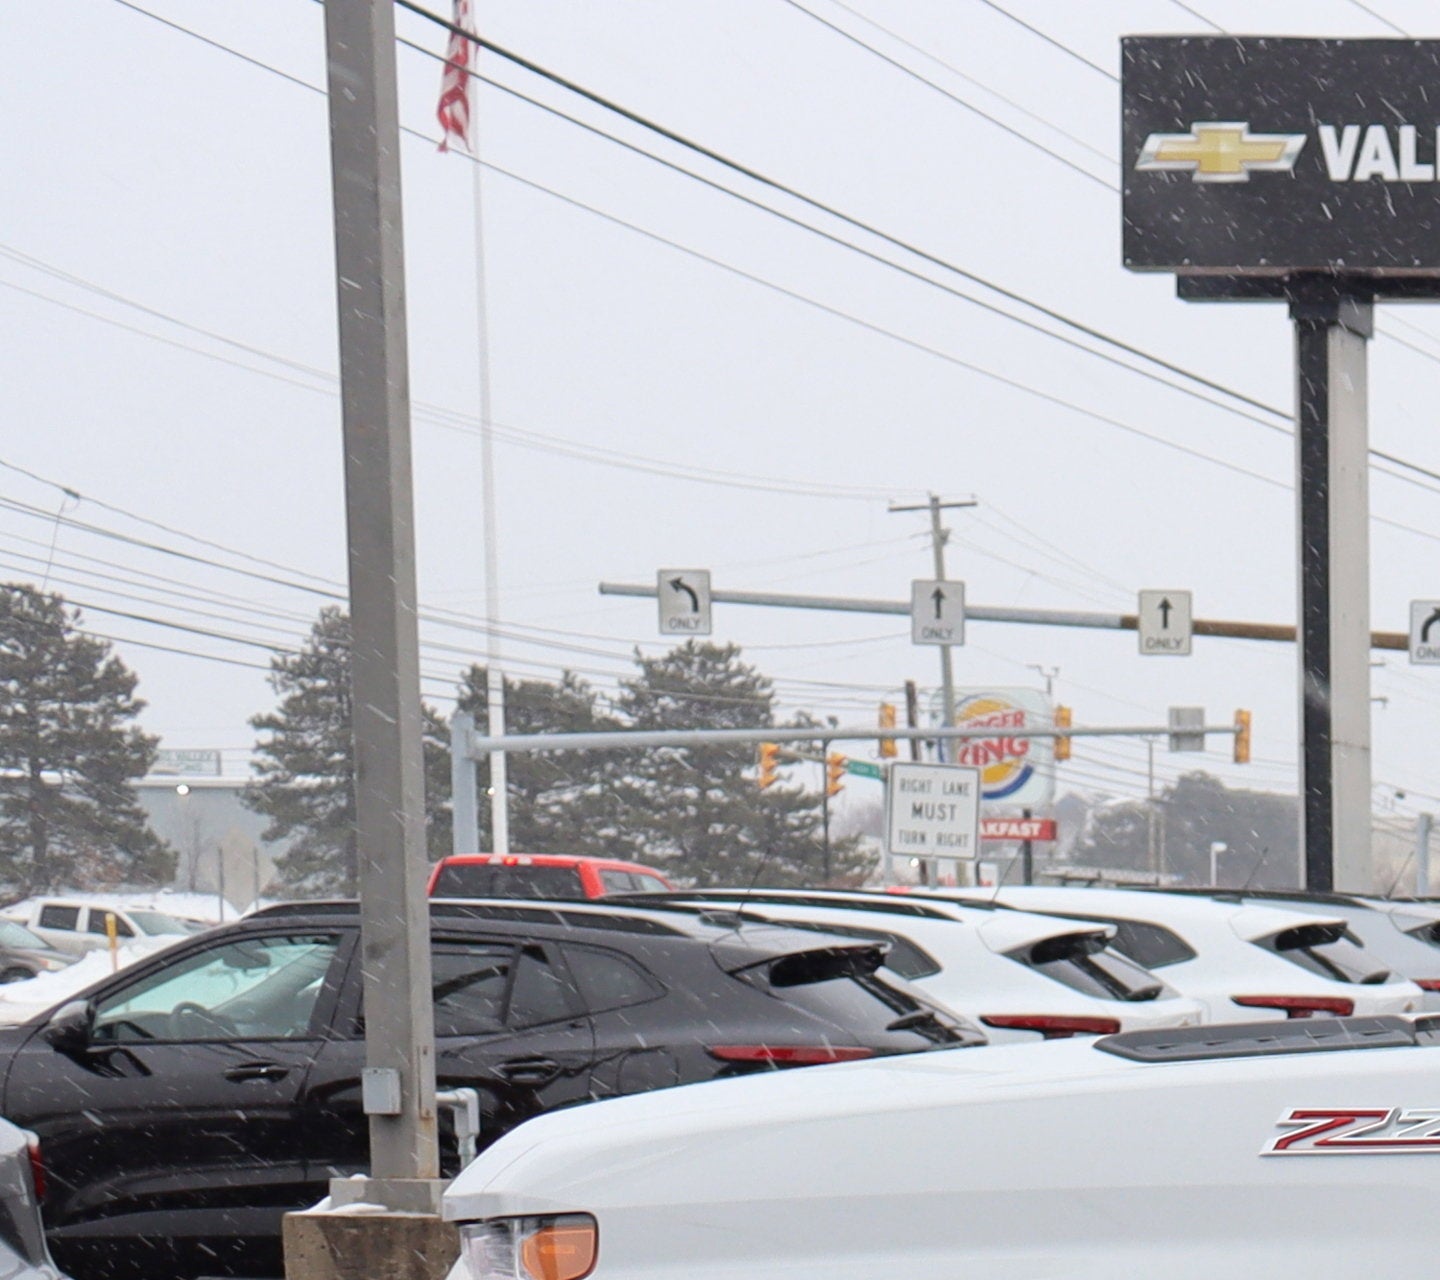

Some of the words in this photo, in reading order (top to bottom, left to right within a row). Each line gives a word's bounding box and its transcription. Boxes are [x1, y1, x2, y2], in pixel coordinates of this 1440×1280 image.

[669, 617, 700, 630] ONLY
[921, 627, 954, 640] ONLY
[1145, 636, 1183, 650] ONLY
[900, 778, 932, 793] RIGHT
[942, 780, 970, 796] LANE
[912, 803, 957, 821] MUST
[899, 829, 926, 845] TURN
[936, 832, 969, 846] RIGHT
